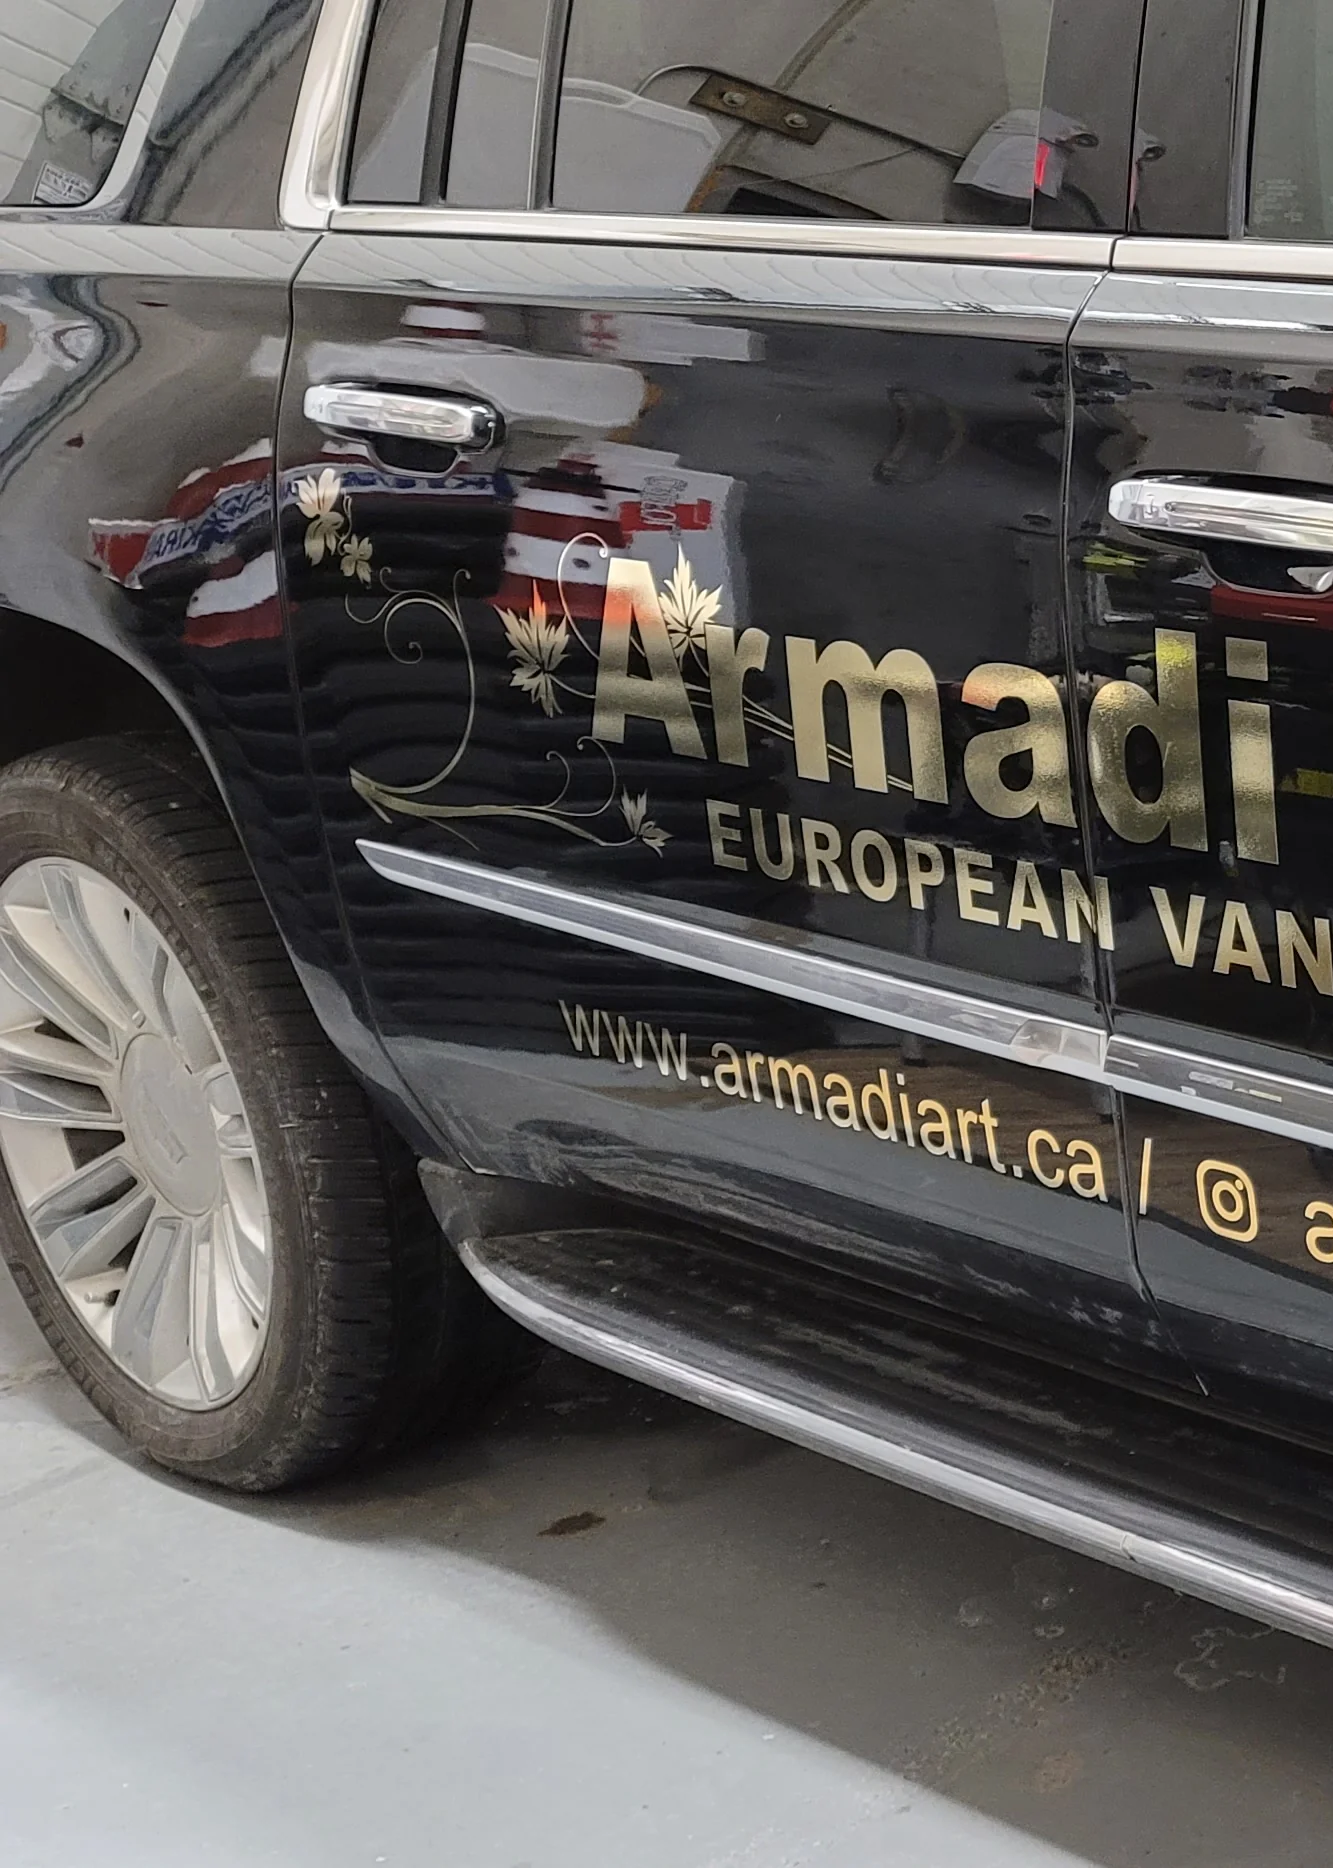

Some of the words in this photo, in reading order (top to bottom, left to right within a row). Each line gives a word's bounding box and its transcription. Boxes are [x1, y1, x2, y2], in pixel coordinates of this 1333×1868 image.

[591, 556, 1280, 865] Armadi
[705, 797, 1116, 952] EUROPEAN
[556, 998, 1109, 1203] www.armadiart.ca
